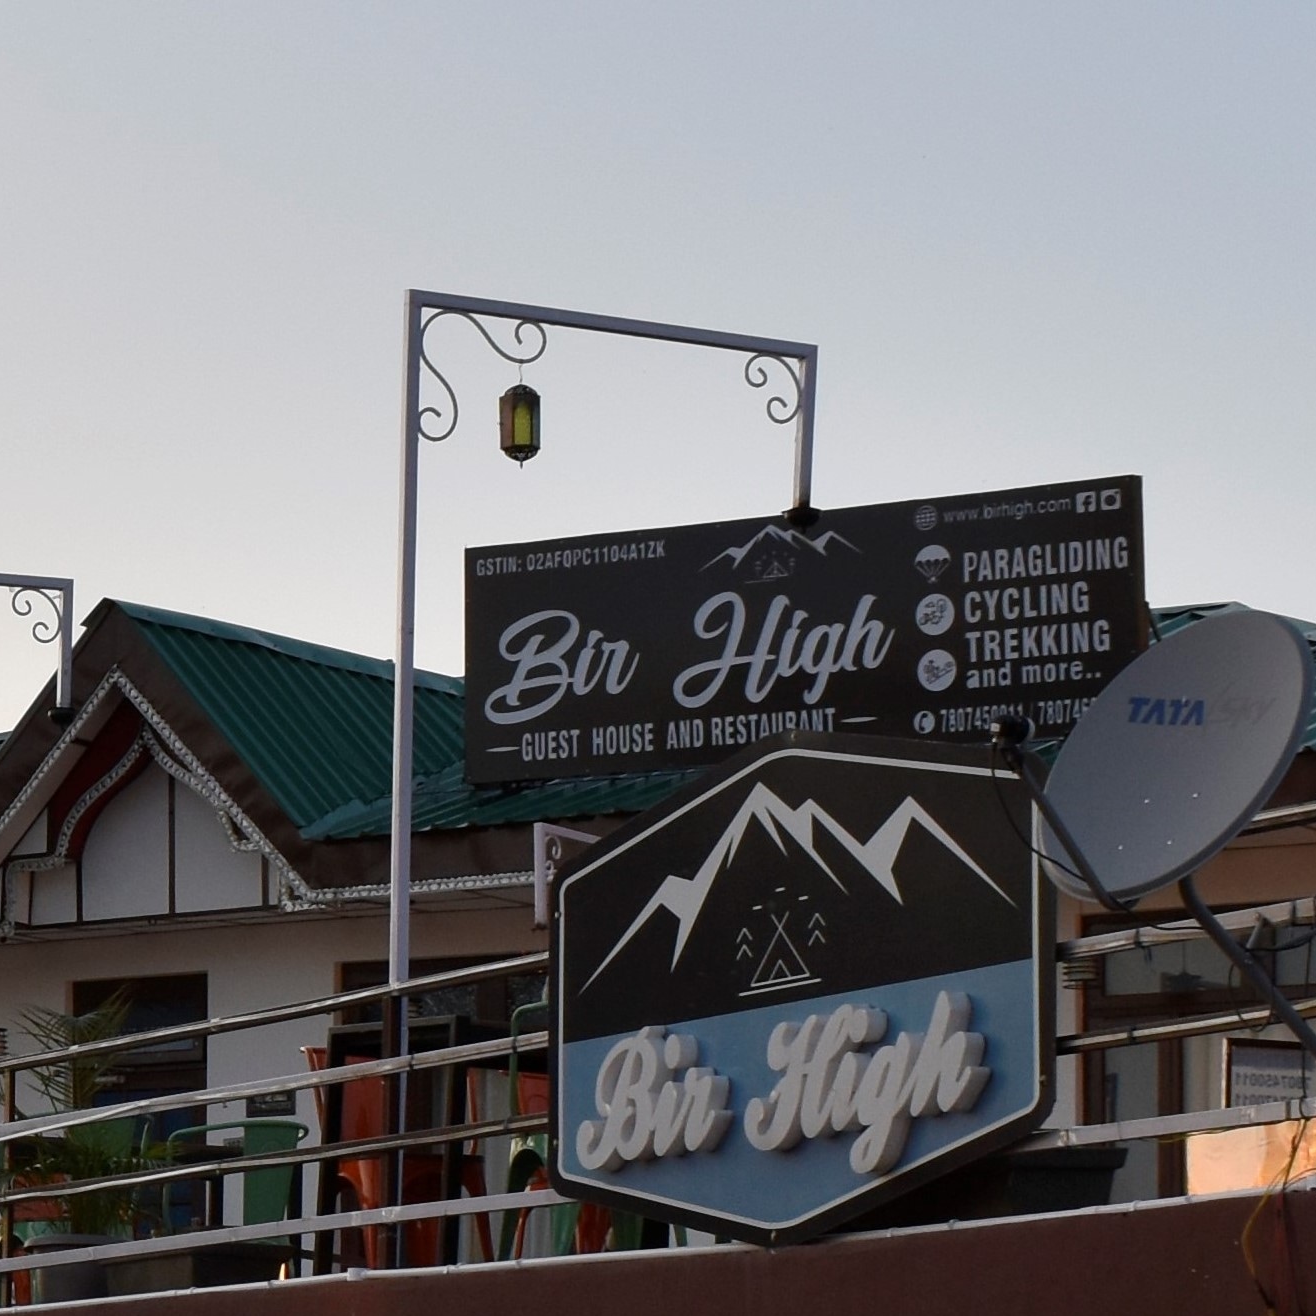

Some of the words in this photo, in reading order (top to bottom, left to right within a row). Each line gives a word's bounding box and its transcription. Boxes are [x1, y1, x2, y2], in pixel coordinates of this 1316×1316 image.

[943, 497, 1071, 523] www.birhigh.com
[476, 555, 522, 576] GSTIN:
[963, 536, 1129, 583] PARAGLIDING
[964, 580, 1090, 624] CYCLING
[484, 609, 640, 725] Bir
[673, 591, 896, 708] High
[964, 619, 1111, 663] TREKKING
[966, 661, 1012, 689] and
[1022, 660, 1102, 684] more..
[1128, 697, 1205, 727] TATA
[521, 729, 580, 762] GUEST
[592, 723, 655, 756] HOUSE
[666, 718, 704, 751] AND
[712, 707, 836, 747] RESTAURANT
[576, 1025, 735, 1172] Bir
[744, 990, 992, 1176] High
